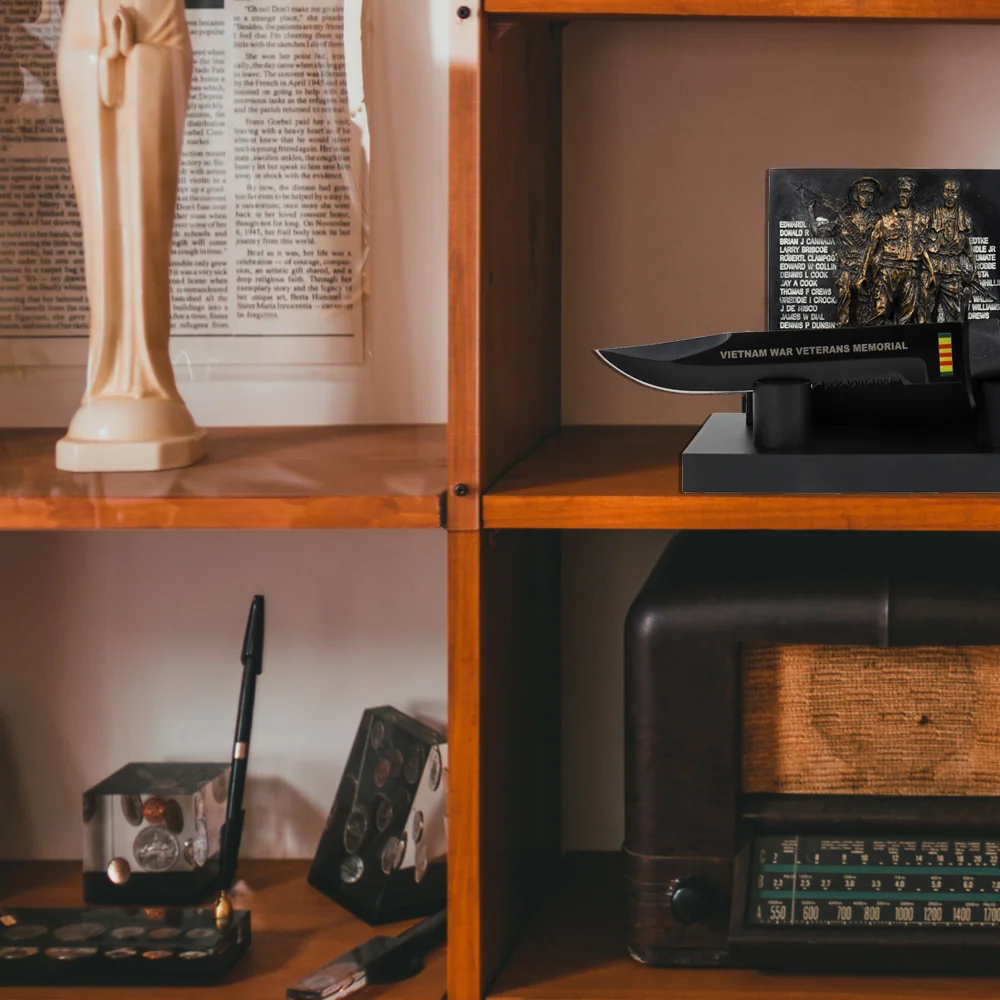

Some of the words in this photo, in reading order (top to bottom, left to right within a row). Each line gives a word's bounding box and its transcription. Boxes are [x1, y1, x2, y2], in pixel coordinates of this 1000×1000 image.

[288, 79, 306, 87] April
[316, 219, 351, 227] November
[779, 229, 803, 237] DONALD
[988, 245, 997, 253] JR
[779, 262, 806, 270] EDWARD
[779, 270, 803, 279] DENNIS
[810, 271, 829, 279] COOK
[780, 279, 792, 287] JAY
[799, 279, 818, 287] COOK
[779, 287, 804, 296] THOMAS
[811, 287, 832, 296] CREWS
[786, 304, 796, 312] DE
[971, 303, 1000, 311] WILLIAMS
[780, 313, 801, 321] JAMES
[779, 321, 804, 329] DENNIS
[720, 349, 767, 360] VIETNAM
[769, 347, 793, 357] WAR
[795, 344, 850, 356] VETERANS
[852, 342, 908, 353] MEMORIAL
[892, 854, 899, 862] 12
[916, 854, 922, 862] 14
[937, 854, 944, 862] 16
[974, 855, 982, 863] 20
[990, 855, 998, 863] 22
[895, 880, 905, 888] 4.0
[931, 880, 941, 888] 5.0
[963, 881, 973, 889] 6.0
[756, 905, 761, 918] A
[770, 905, 786, 919] 550
[803, 905, 819, 920] 600
[837, 906, 852, 920] 700
[864, 906, 880, 920] 800
[895, 906, 914, 921] 1000
[924, 906, 942, 921] 1200
[953, 907, 971, 921] 1400
